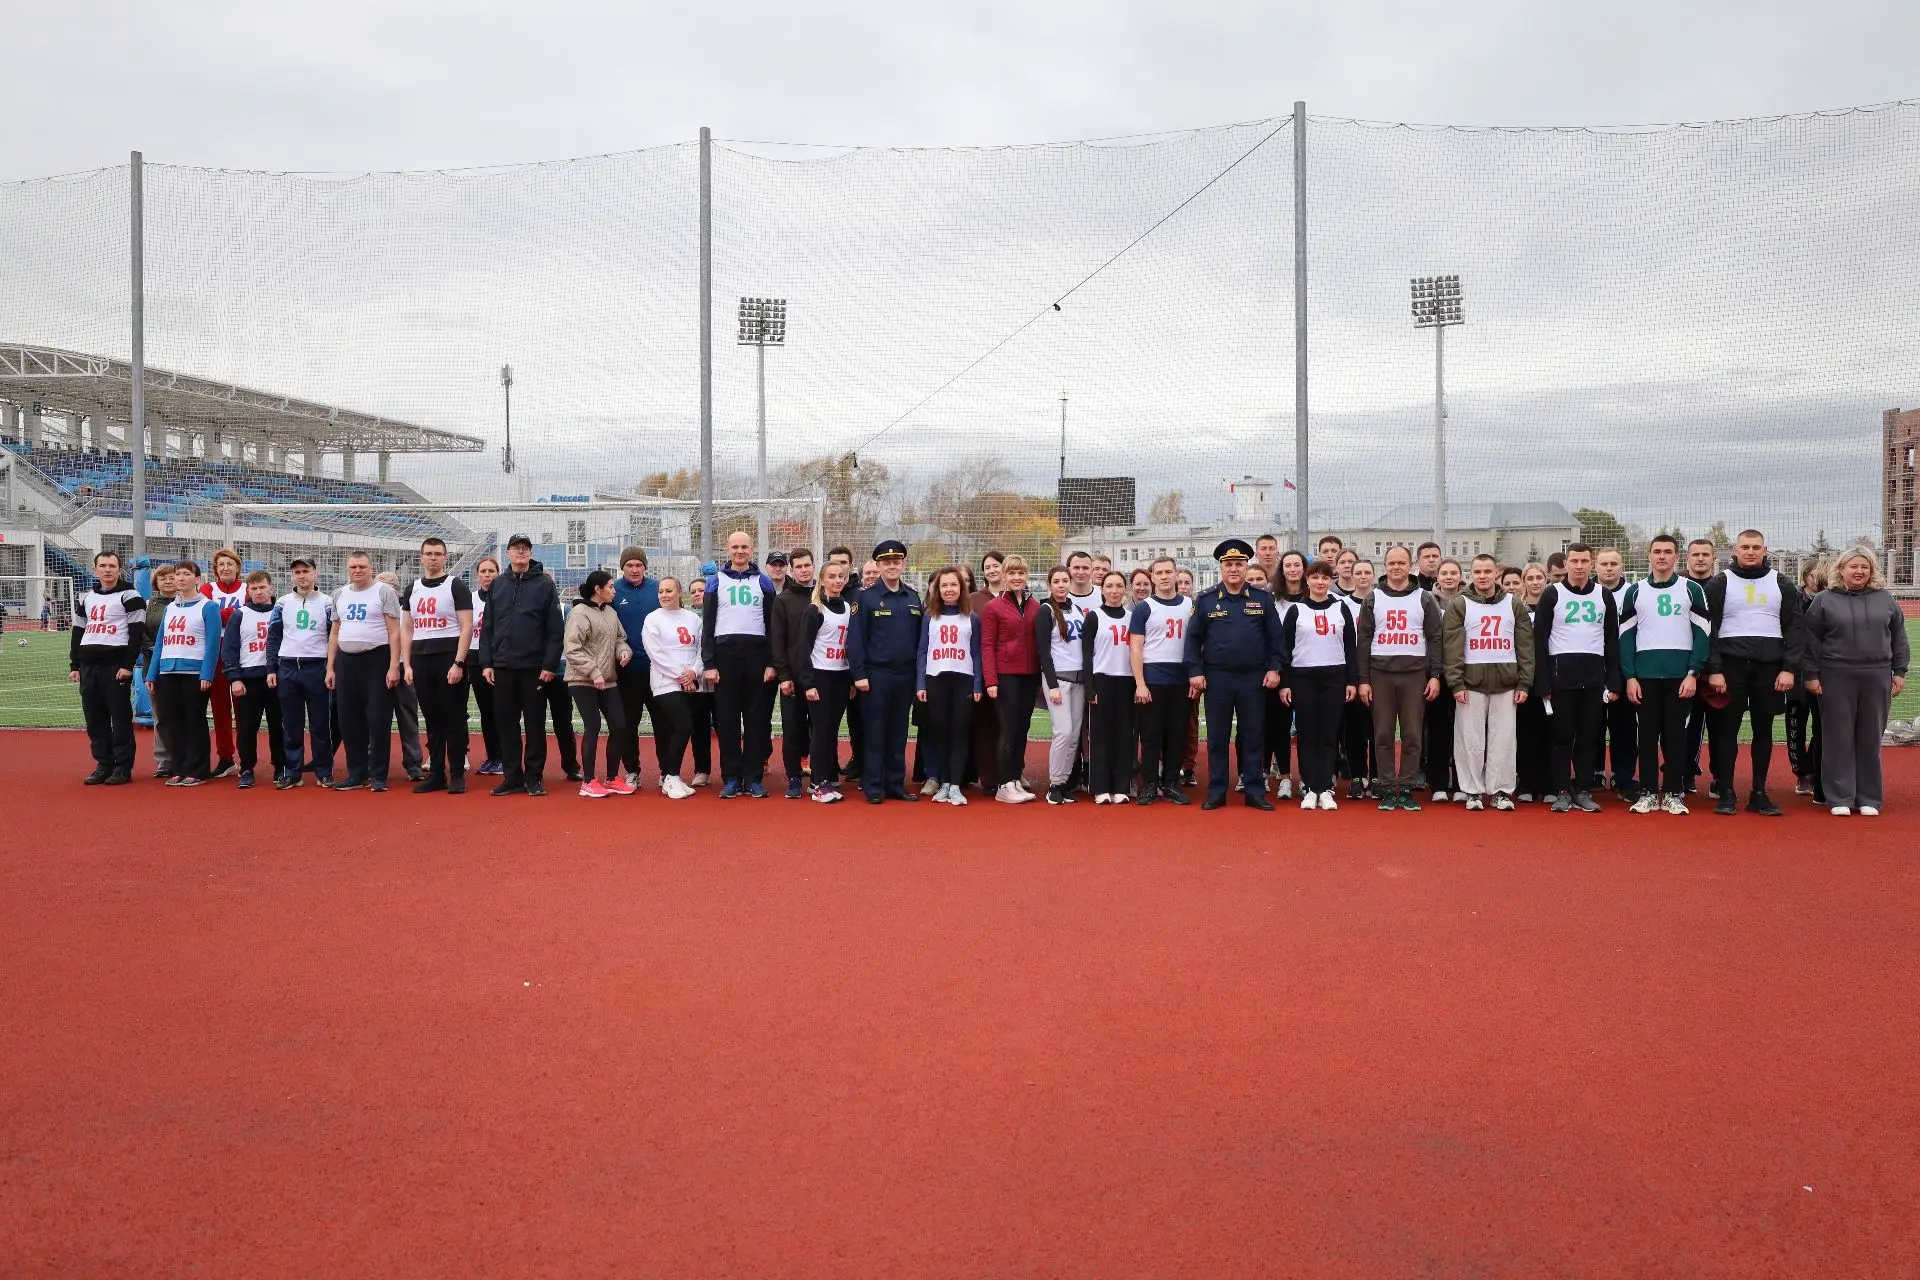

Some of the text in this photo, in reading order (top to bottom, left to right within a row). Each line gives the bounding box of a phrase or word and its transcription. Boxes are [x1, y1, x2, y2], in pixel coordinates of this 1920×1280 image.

[91, 604, 106, 621] 41
[347, 604, 367, 620] 35
[417, 598, 437, 615] 48
[168, 615, 186, 632] 44
[1166, 619, 1183, 639] 31
[1386, 610, 1408, 631] 55
[1480, 616, 1502, 636] 27
[257, 622, 270, 639] 5
[838, 625, 848, 645] 7
[940, 625, 959, 644] 88
[1109, 625, 1131, 646] 14
[1377, 633, 1419, 645] ВИПЭ
[1469, 638, 1511, 650] ВИПЭ
[933, 648, 966, 661] ВИПЭ
